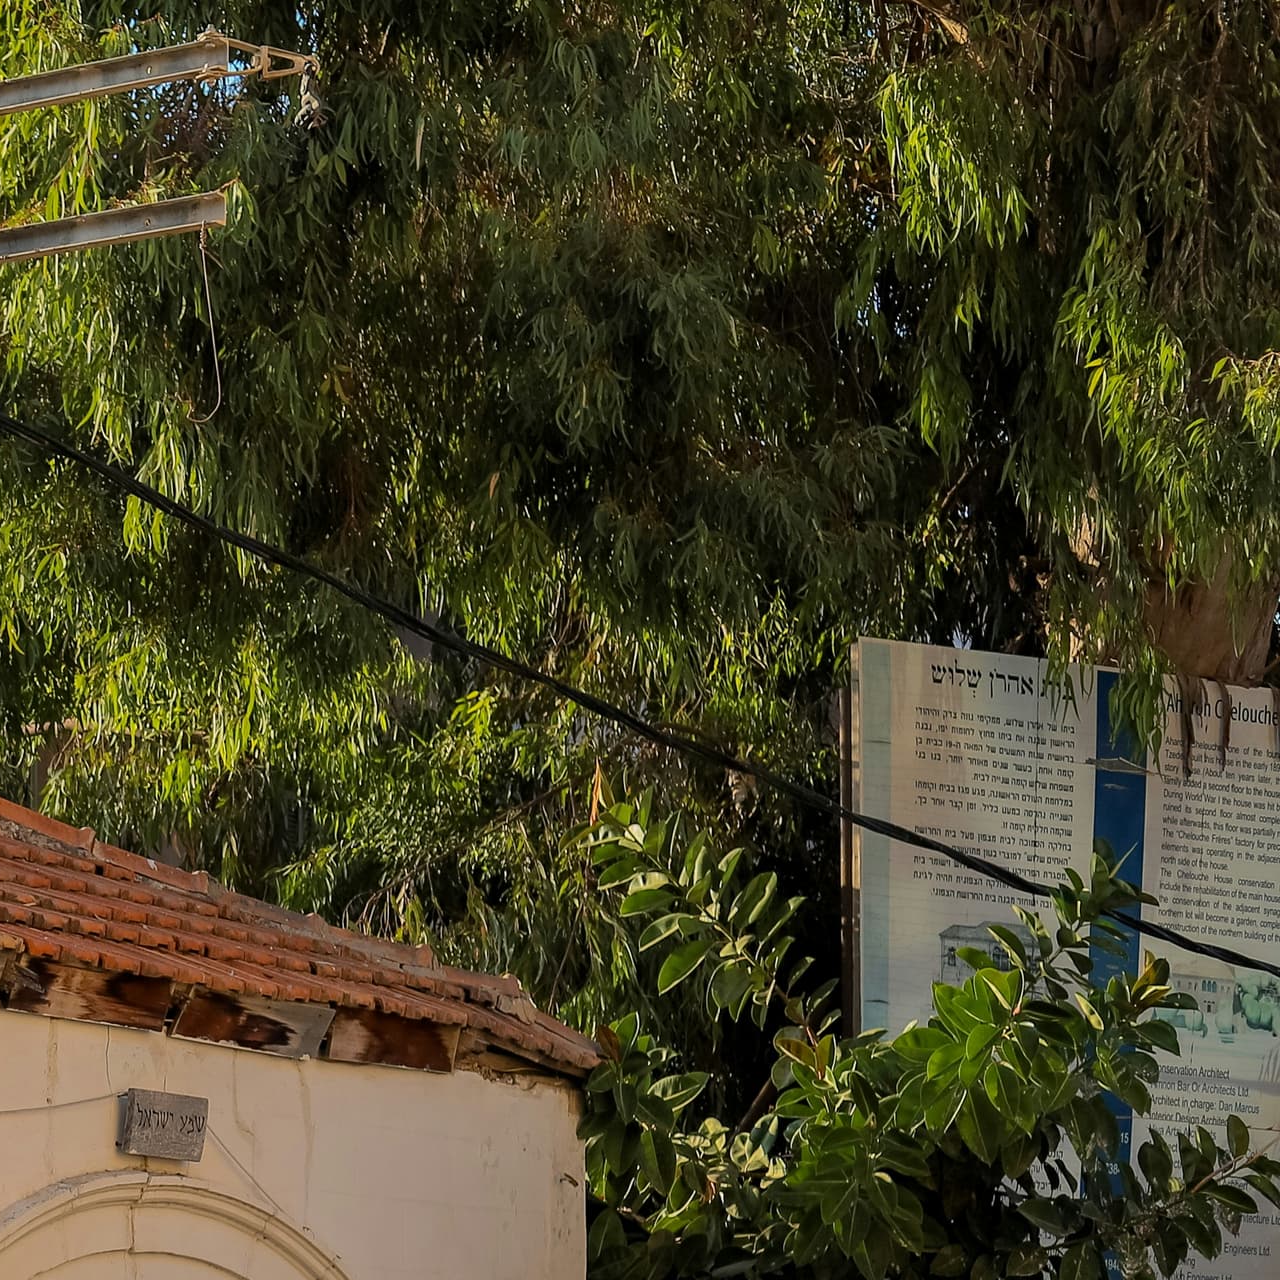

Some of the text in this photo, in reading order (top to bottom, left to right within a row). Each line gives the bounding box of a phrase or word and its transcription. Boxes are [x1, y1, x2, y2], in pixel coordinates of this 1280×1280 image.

[1163, 788, 1183, 801] During
[1199, 1066, 1230, 1080] Architect
[1218, 1101, 1233, 1111] Dan
[1234, 1103, 1260, 1114] Marcus
[137, 1102, 174, 1128] ישראל
